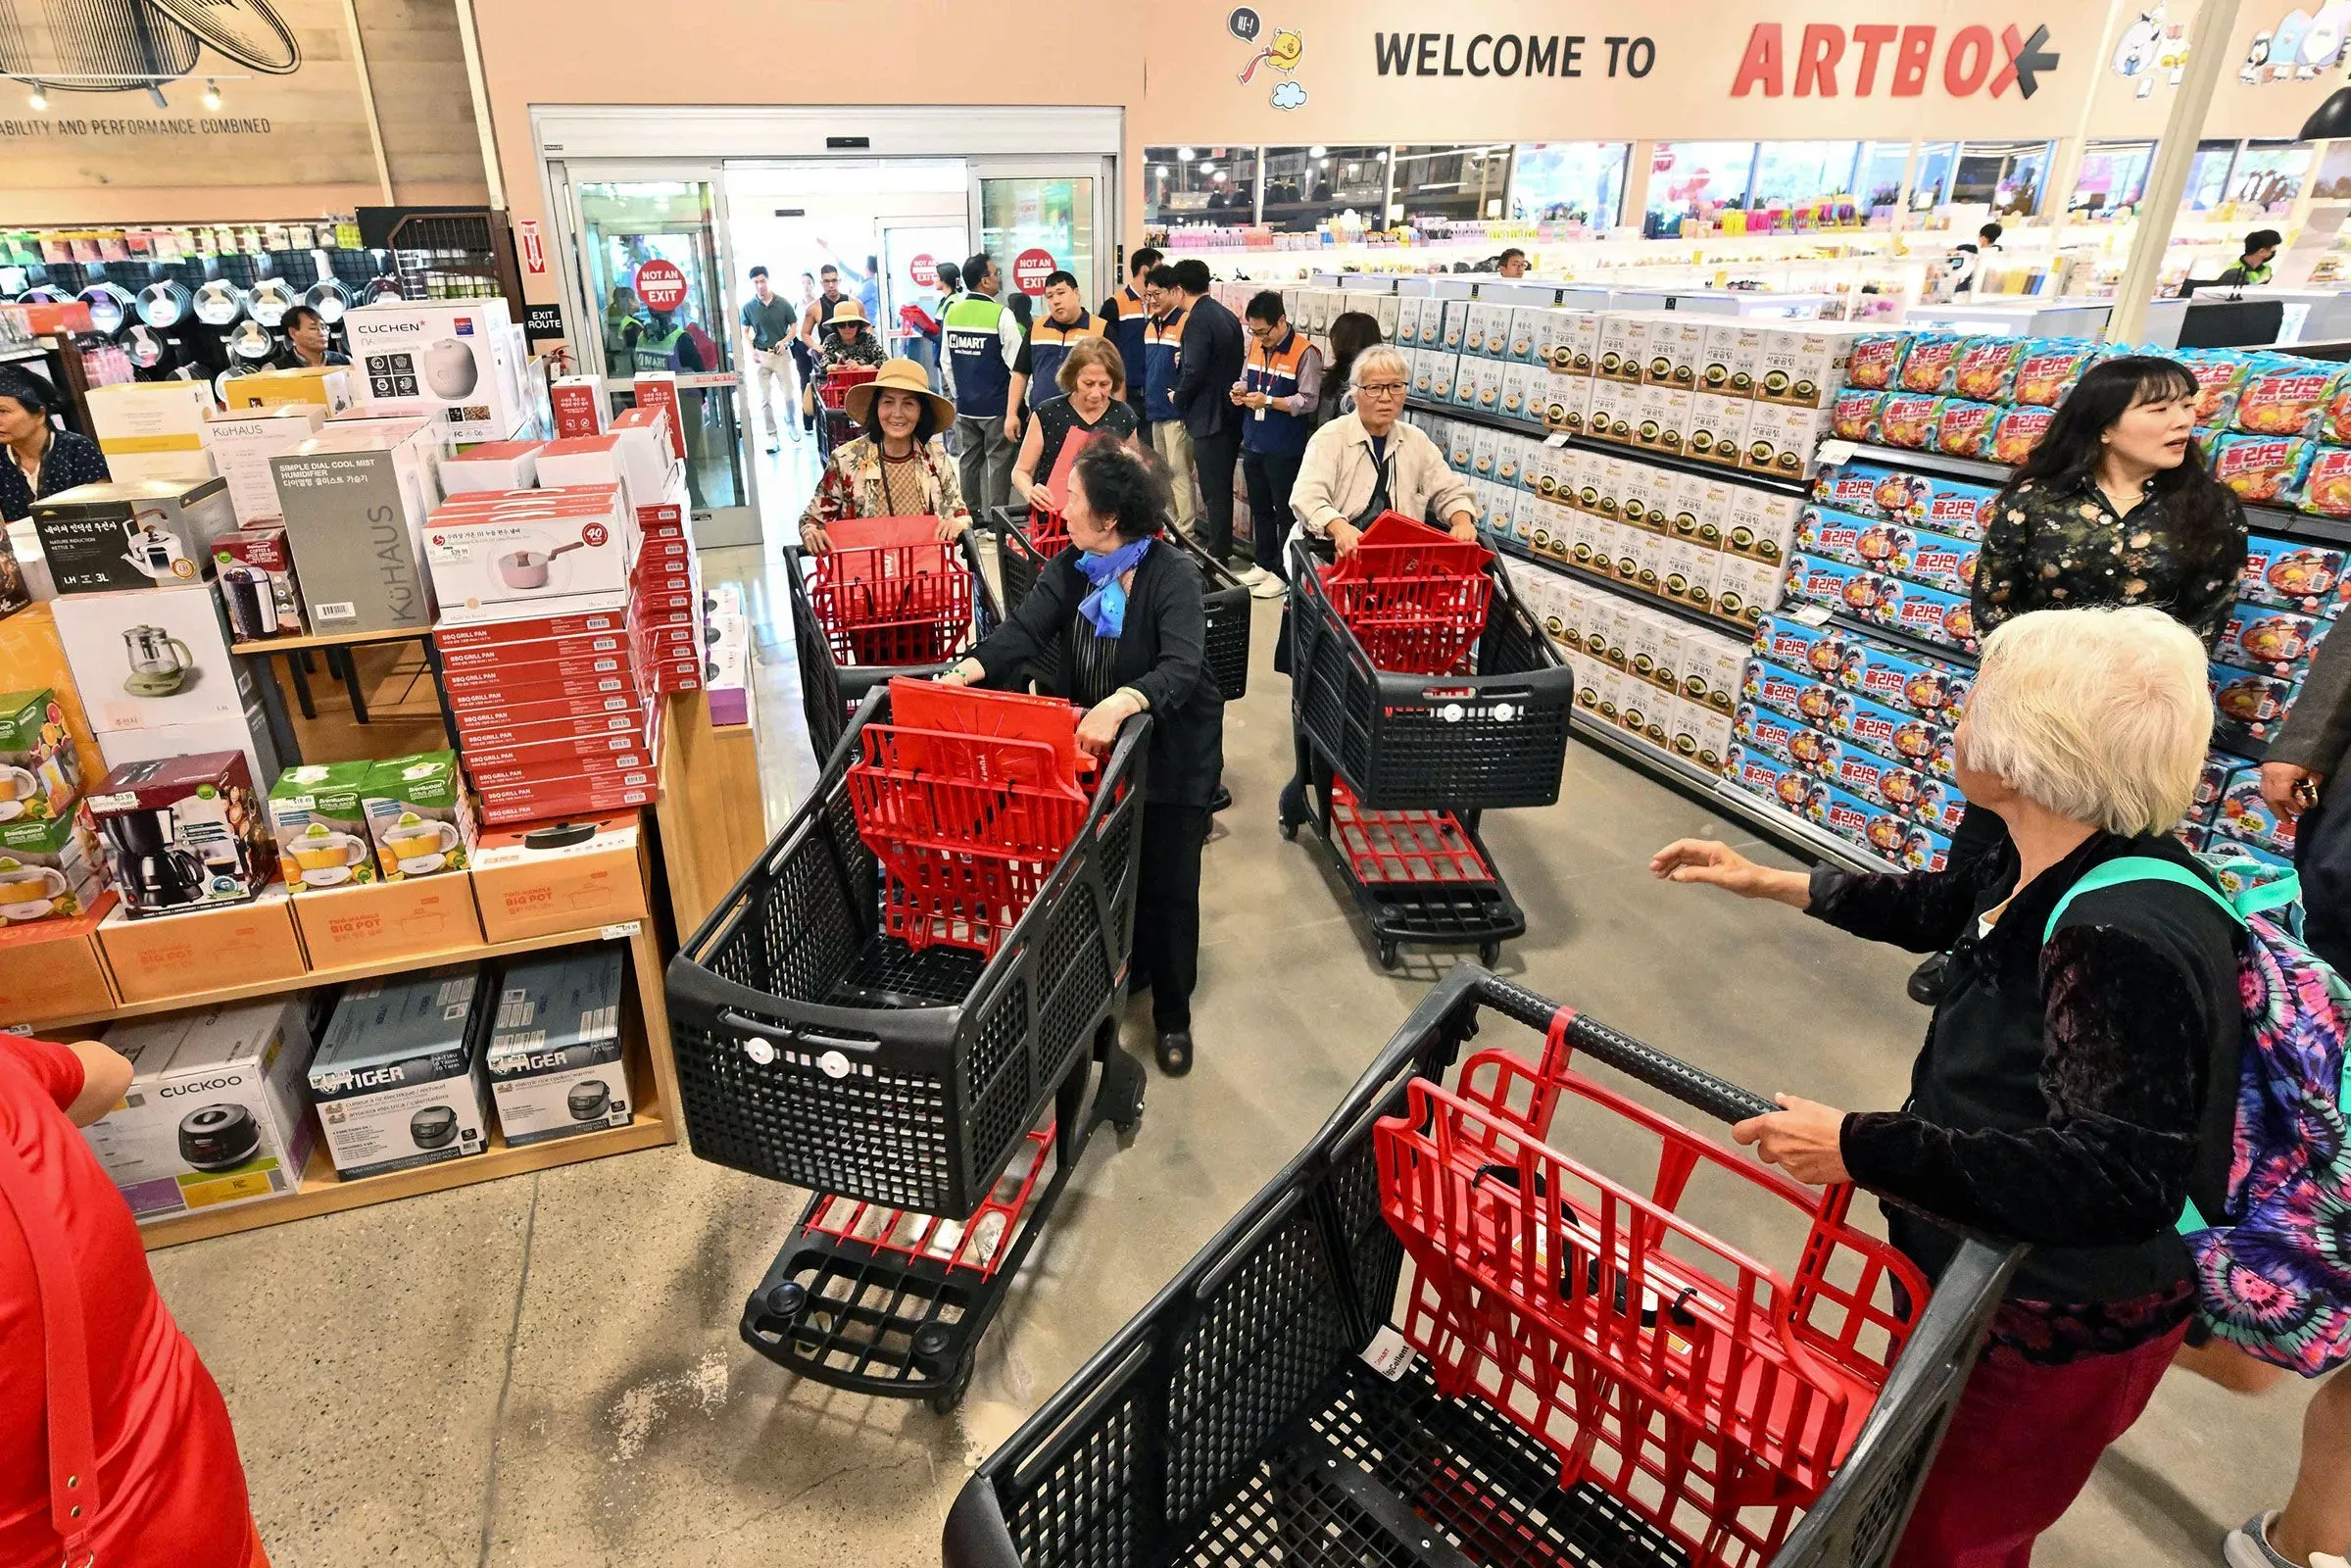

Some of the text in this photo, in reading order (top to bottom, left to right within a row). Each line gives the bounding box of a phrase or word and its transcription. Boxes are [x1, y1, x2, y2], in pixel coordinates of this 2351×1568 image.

[1375, 31, 1656, 78] WELCOME TO
[1730, 22, 2054, 99] ARTBOX
[58, 120, 86, 135] AND
[92, 119, 196, 135] PERFORMANCE
[200, 118, 270, 134] COMBINED
[1018, 257, 1052, 268] NOT AN
[642, 270, 679, 280] NOT AN
[648, 290, 677, 303] EXIT
[531, 311, 554, 320] EXIT
[358, 323, 420, 334] CUCHEN
[527, 319, 562, 329] ROUTE
[958, 336, 987, 349] MART
[2025, 356, 2075, 372] 훌라면
[2258, 376, 2328, 395] 훌라면
[2279, 392, 2320, 401] RAMYUN
[1890, 400, 1935, 415] 훌라면
[1945, 410, 1986, 424] 훌라면
[2008, 414, 2051, 428] 훌라면
[2225, 443, 2289, 465] 훌라면
[279, 463, 310, 472] SIMPLE
[311, 462, 330, 470] DIAL
[356, 459, 375, 467] MIST
[2246, 459, 2284, 467] RAMYUN
[281, 469, 328, 479] HUMIDIFIER
[346, 474, 368, 483] 가습기
[1836, 480, 1874, 496] 훌라면
[1932, 500, 1976, 516] 훌라면
[586, 527, 603, 538] 40
[1915, 554, 1958, 569] 훌라면
[95, 572, 110, 582] 3L
[1806, 576, 1843, 592] 훌라면
[1901, 602, 1944, 618] 훌라면
[1773, 638, 1808, 655] 훌라면
[1865, 670, 1905, 689] 훌라면
[1853, 717, 1893, 736] 훌라면
[1840, 761, 1880, 781] 훌라면
[408, 781, 445, 794] Brentwood
[318, 794, 357, 805] Brentwood
[1829, 807, 1868, 827] 훌라면
[505, 892, 553, 906] BIG POT
[329, 918, 381, 934] BIG POT
[512, 1052, 567, 1072] TIGER
[343, 1065, 406, 1091] TIGER
[160, 1075, 243, 1099] CUCKOO
